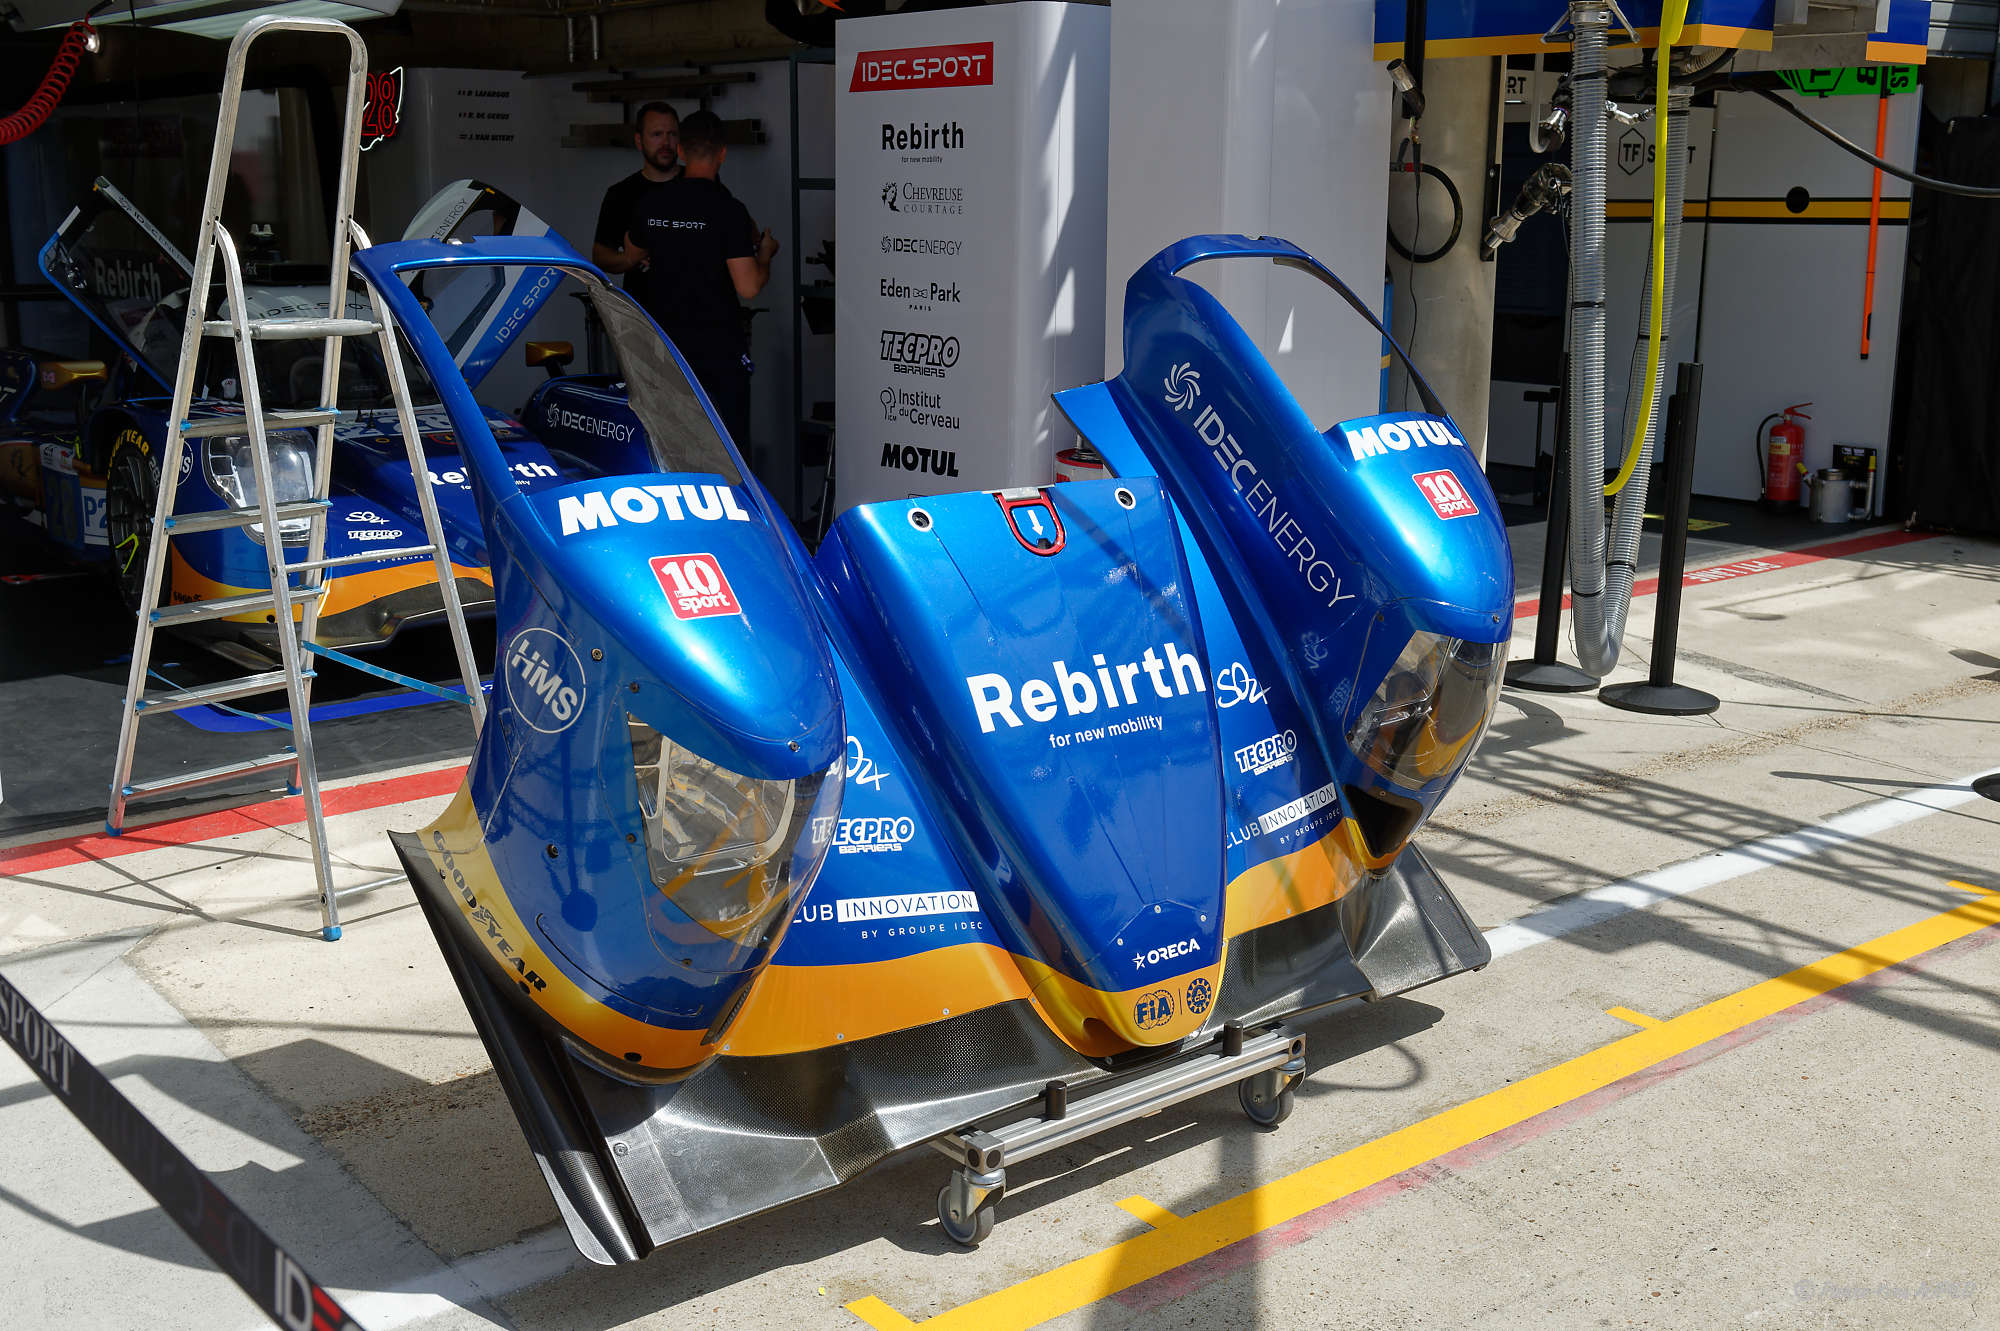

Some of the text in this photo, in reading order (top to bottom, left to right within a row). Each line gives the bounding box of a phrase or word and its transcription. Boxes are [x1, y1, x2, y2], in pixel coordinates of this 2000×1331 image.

[862, 54, 986, 82] IDEC.SPORT
[361, 72, 396, 138] 28
[882, 121, 964, 150] Rebirth
[922, 156, 943, 164] mobility
[1623, 144, 1641, 161] TF
[903, 182, 963, 201] CHEVREUSE
[903, 204, 963, 215] COURTAGE
[648, 218, 707, 230] IDEC SPORT
[94, 257, 162, 301] Rebirth
[880, 278, 961, 303] Eden Park
[909, 304, 932, 312] PARIS
[880, 330, 960, 368] TECPRO
[893, 364, 946, 378] BARRIERS
[899, 389, 941, 409] Institut
[899, 408, 960, 429] du Cerveau
[1345, 419, 1464, 461] MOTUL
[411, 462, 558, 486] Reth
[881, 443, 959, 478] MOTUL
[1422, 475, 1462, 503] 10
[558, 484, 750, 536] MOTUL
[1438, 498, 1471, 515] sport
[348, 530, 403, 540] TECPRO
[661, 559, 721, 597] 10
[678, 591, 731, 614] sport
[966, 642, 1206, 734] Rebirth
[1049, 714, 1163, 749] for new mobility
[1234, 729, 1297, 774] TECPRO
[1264, 787, 1335, 830] INNOVATION
[1279, 834, 1290, 845] BY
[1295, 817, 1324, 837] GROUPE
[433, 830, 547, 992] GOODYEAR
[793, 893, 974, 924] UB INNOVATION
[861, 920, 983, 939] BY GROUPE IDEC
[1147, 938, 1201, 965] ORECA
[0, 982, 76, 1096] SPORT
